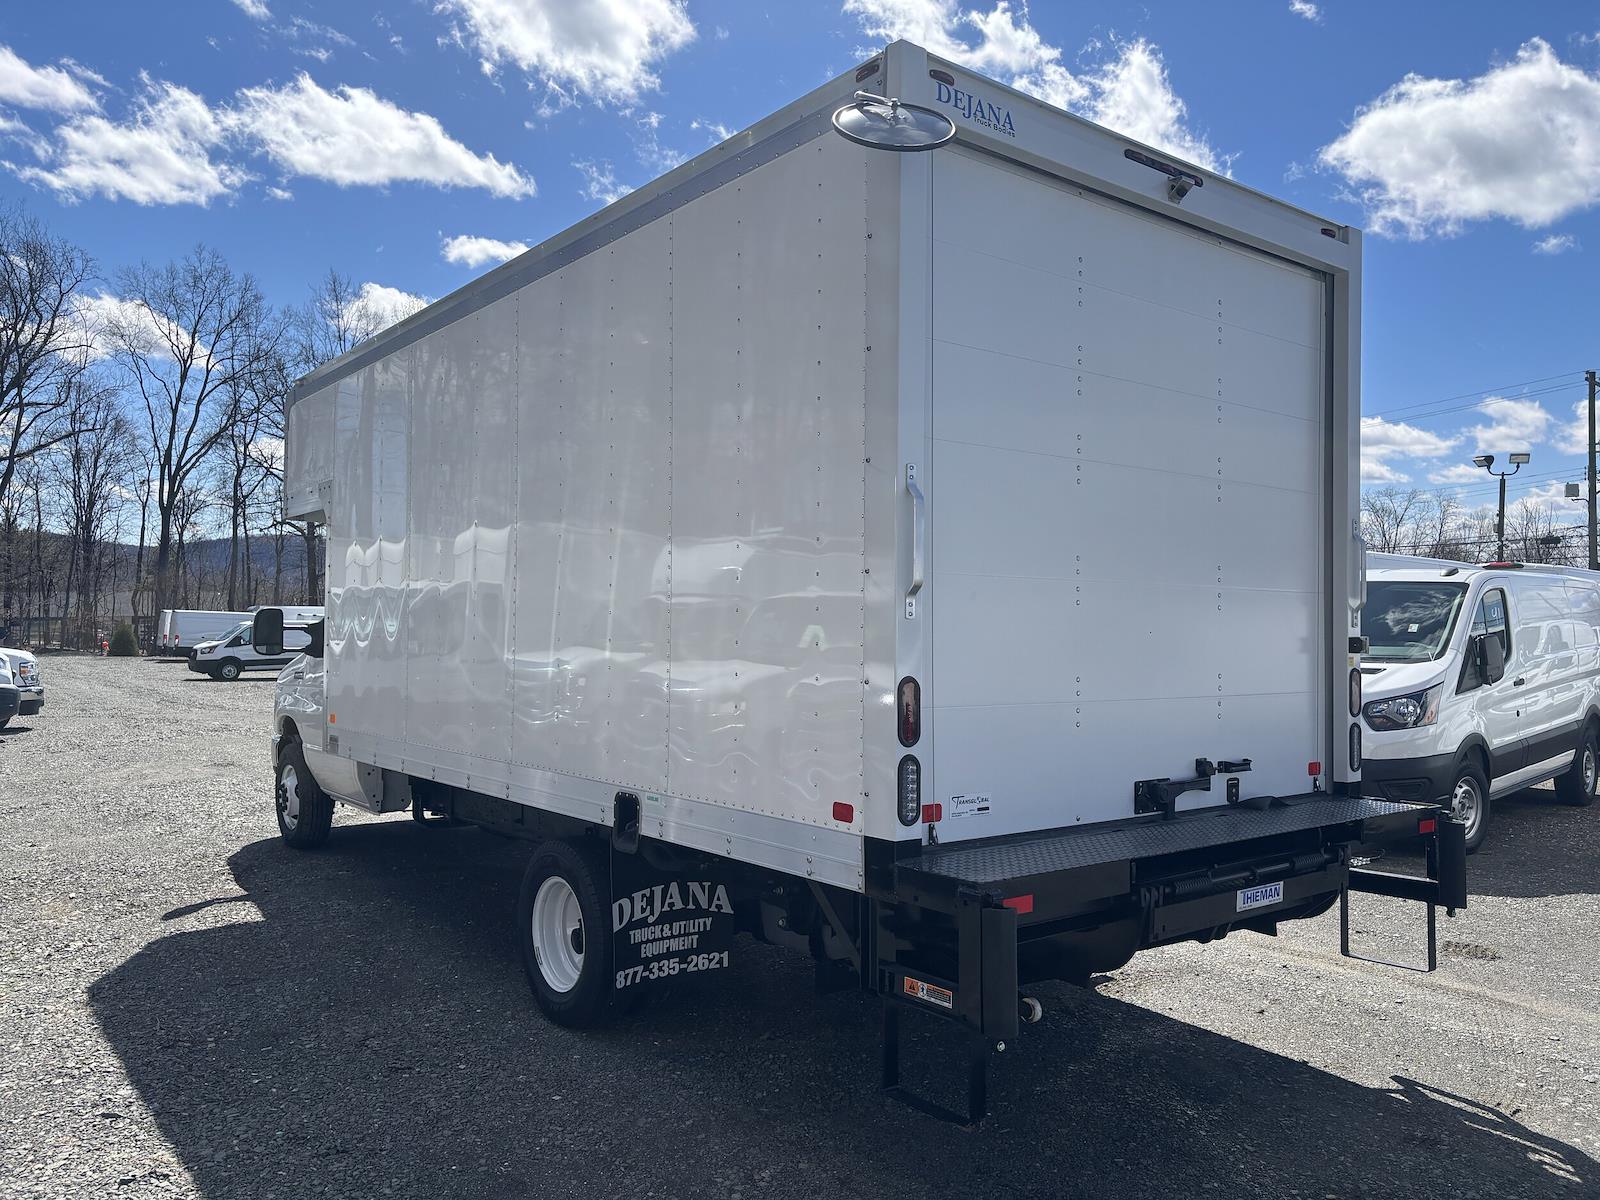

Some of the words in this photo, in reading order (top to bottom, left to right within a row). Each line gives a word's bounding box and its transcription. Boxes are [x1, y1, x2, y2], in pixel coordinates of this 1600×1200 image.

[936, 81, 1015, 132] DEJANA
[973, 115, 992, 129] Truck
[993, 123, 1016, 138] Bodies
[612, 881, 734, 933] DEJANA
[1241, 884, 1281, 906] THIEMAN
[640, 935, 699, 958] EQUIPMENT
[615, 950, 729, 990] 877-335-2621
